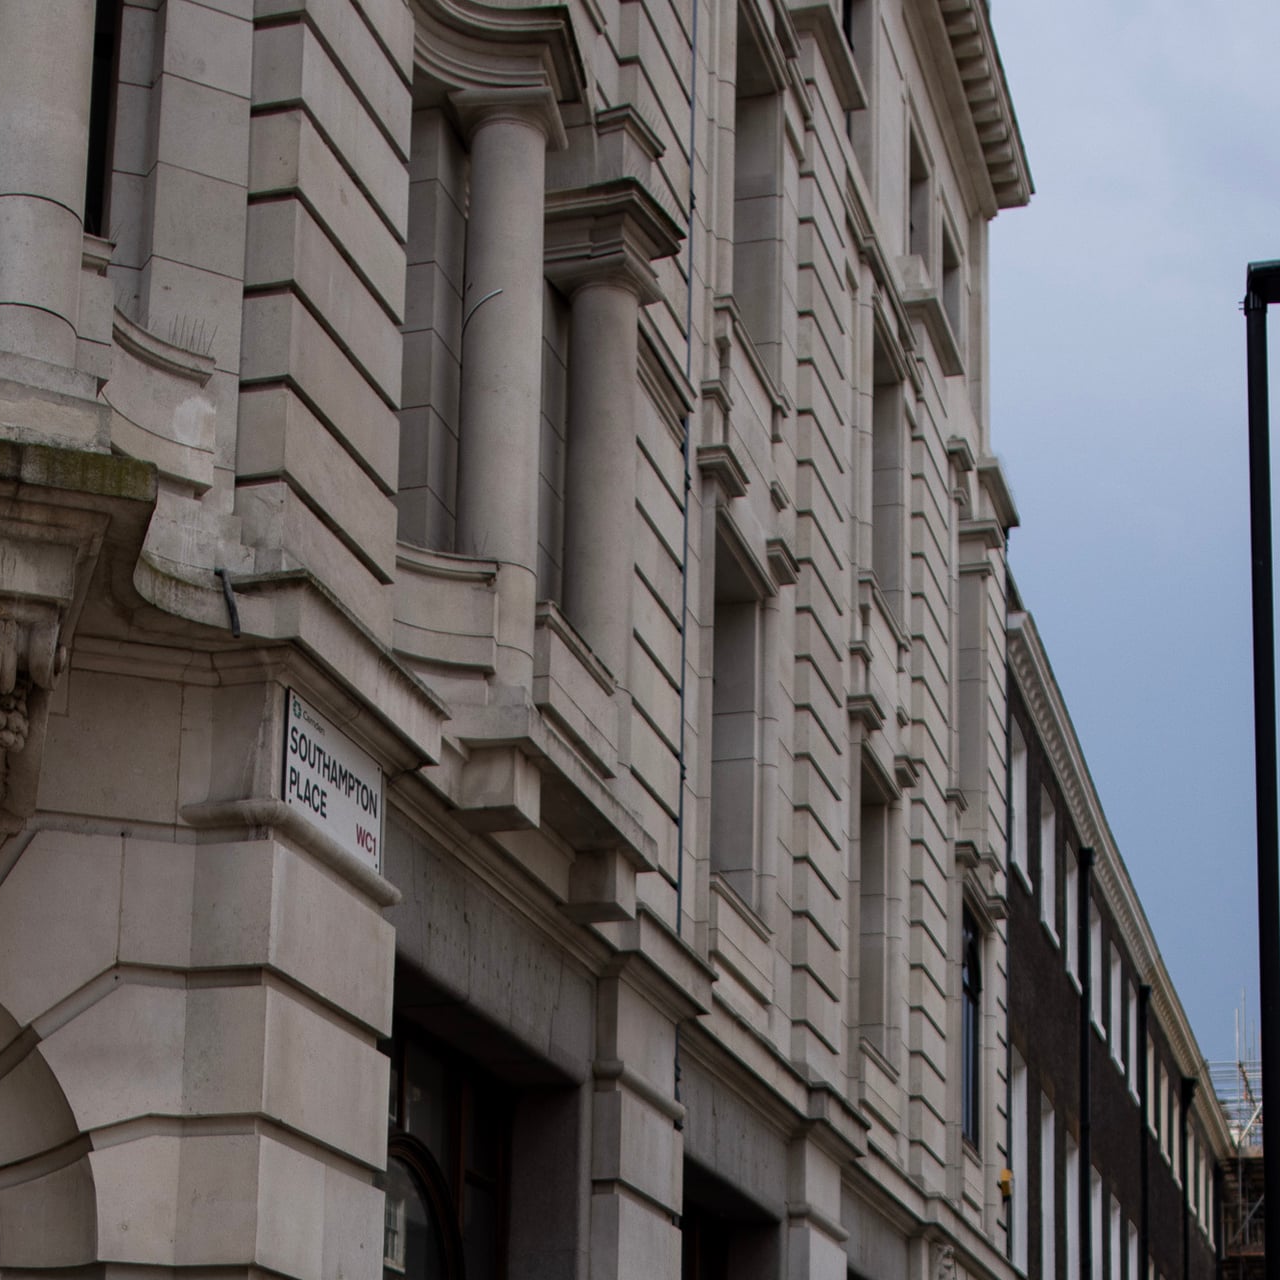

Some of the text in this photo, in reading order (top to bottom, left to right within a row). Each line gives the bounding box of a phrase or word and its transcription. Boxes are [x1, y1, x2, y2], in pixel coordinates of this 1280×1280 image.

[290, 726, 378, 819] SOUTHAMPTON
[290, 766, 327, 819] PLACE
[356, 823, 377, 856] WC1
